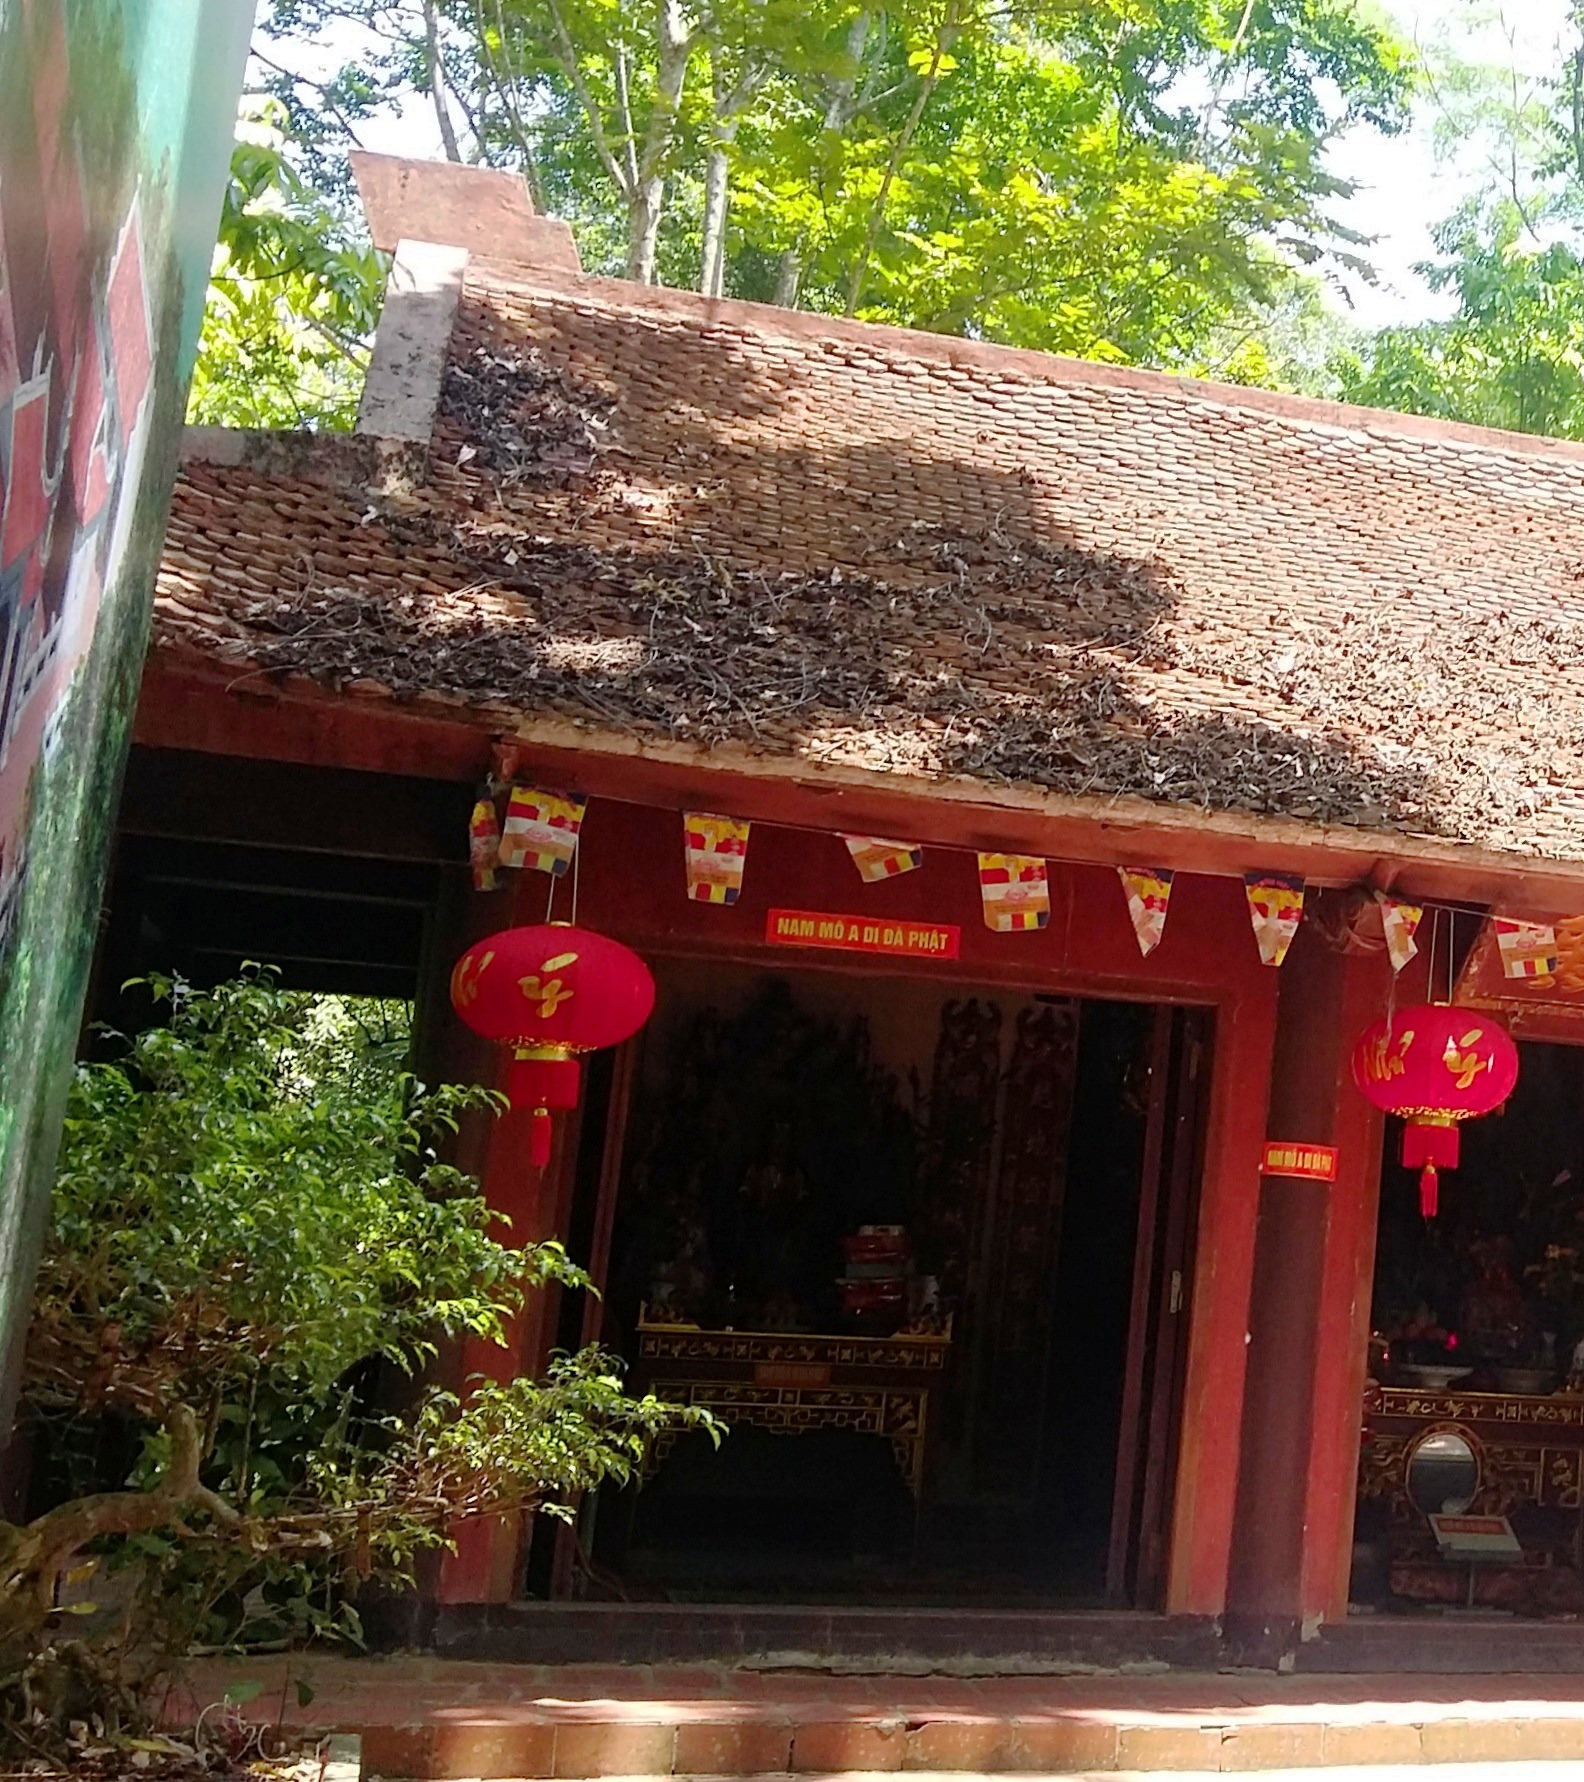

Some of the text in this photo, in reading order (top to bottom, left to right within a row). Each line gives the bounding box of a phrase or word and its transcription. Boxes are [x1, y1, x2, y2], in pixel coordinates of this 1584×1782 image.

[777, 917, 949, 953] NAM MÔ A DI ĐÀ PHẬT
